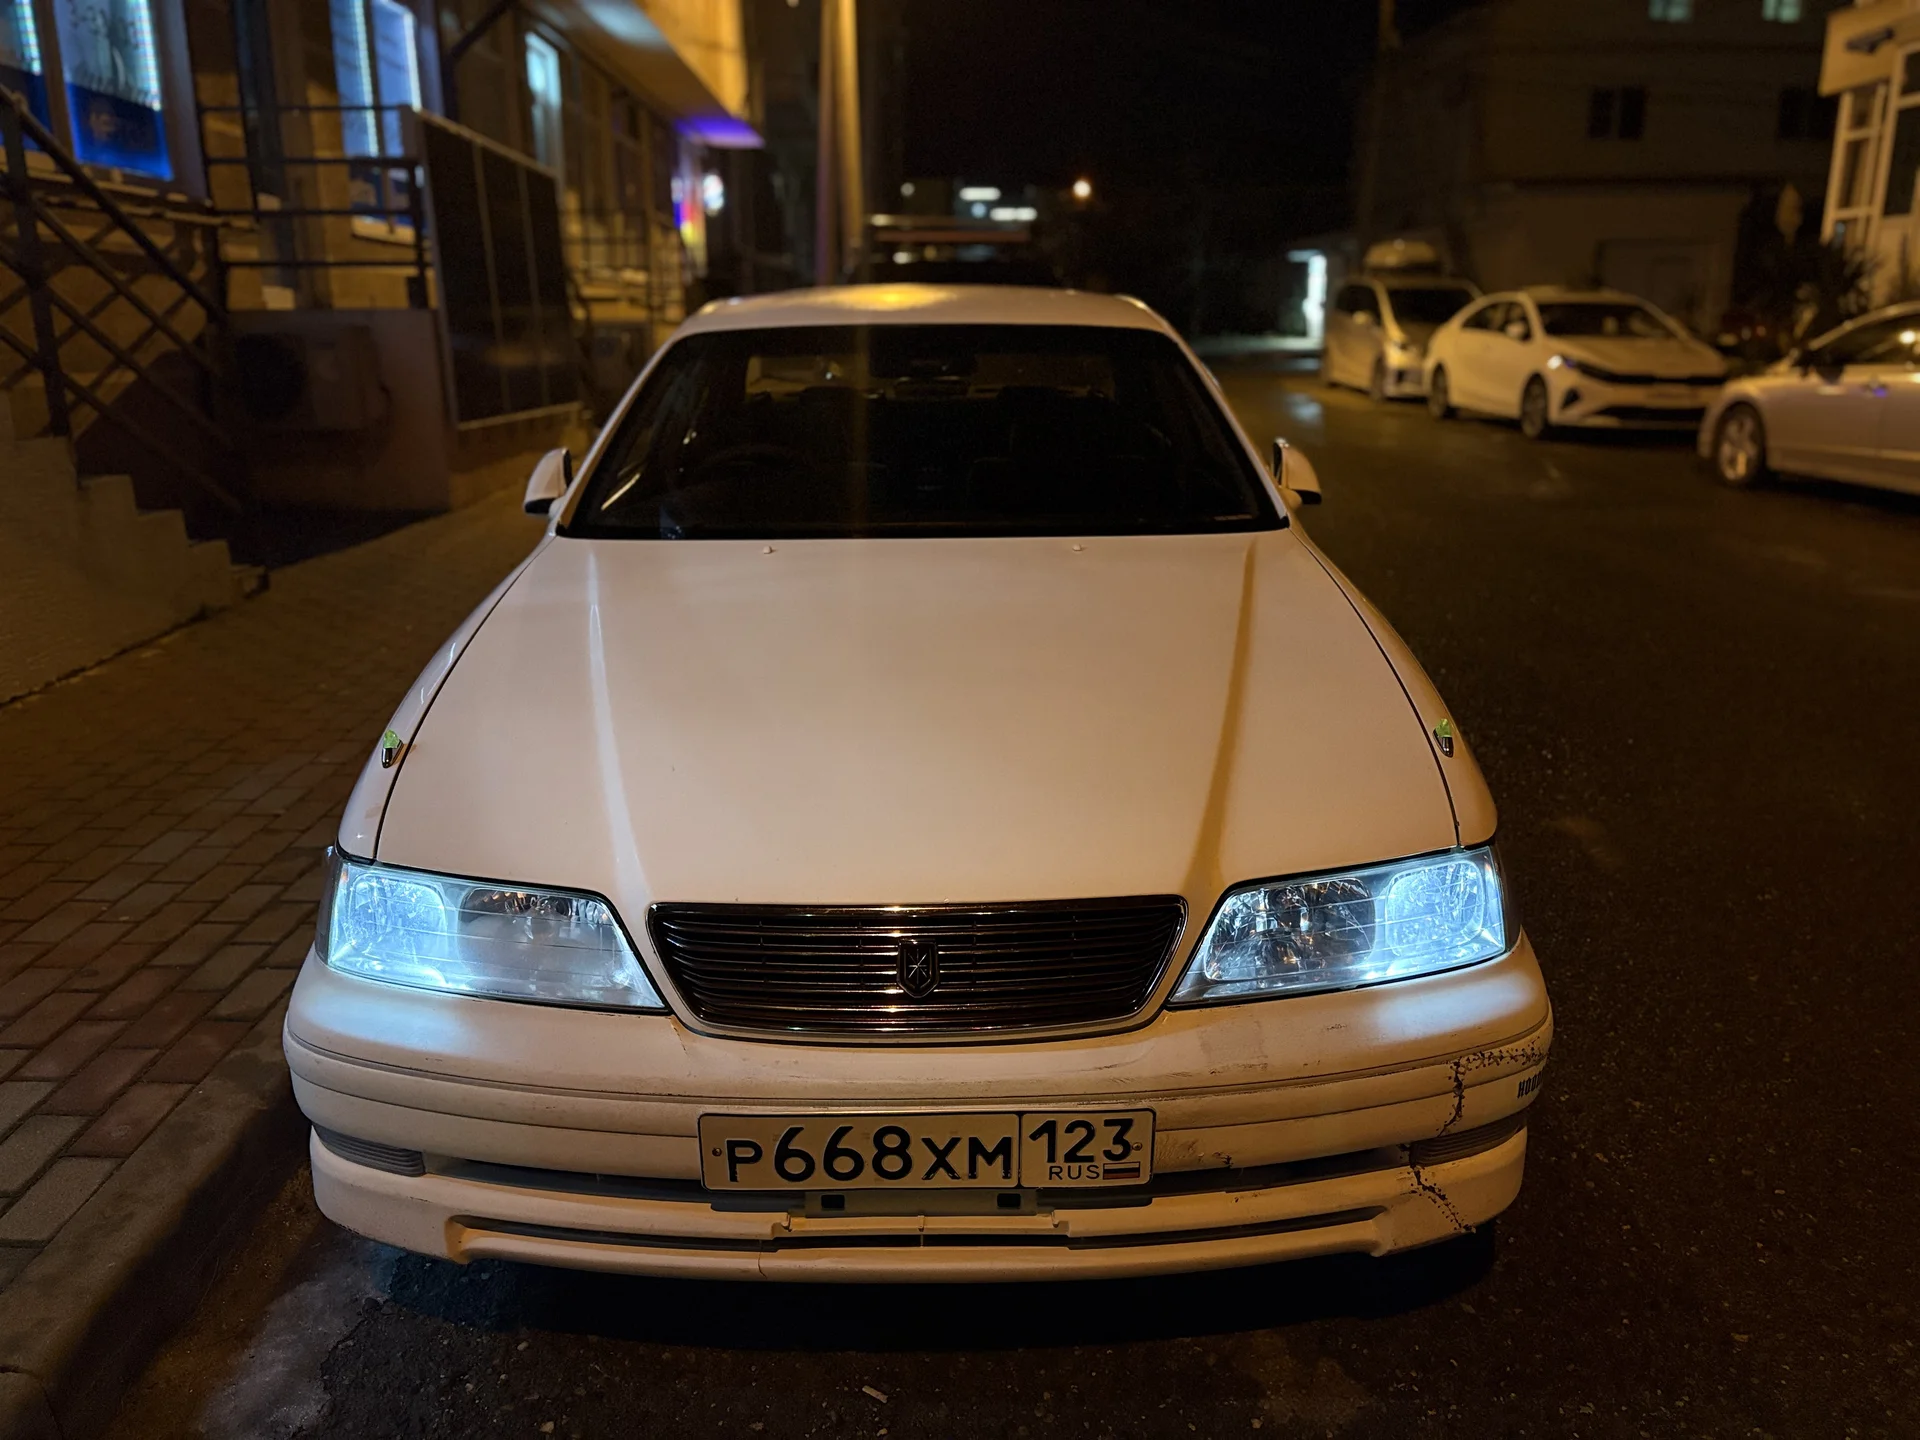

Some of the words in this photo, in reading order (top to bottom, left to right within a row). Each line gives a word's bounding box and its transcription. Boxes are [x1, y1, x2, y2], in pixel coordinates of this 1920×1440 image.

[726, 1125, 1012, 1182] Р668ХМ
[1029, 1119, 1133, 1163] 123
[1049, 1165, 1100, 1180] RUS
